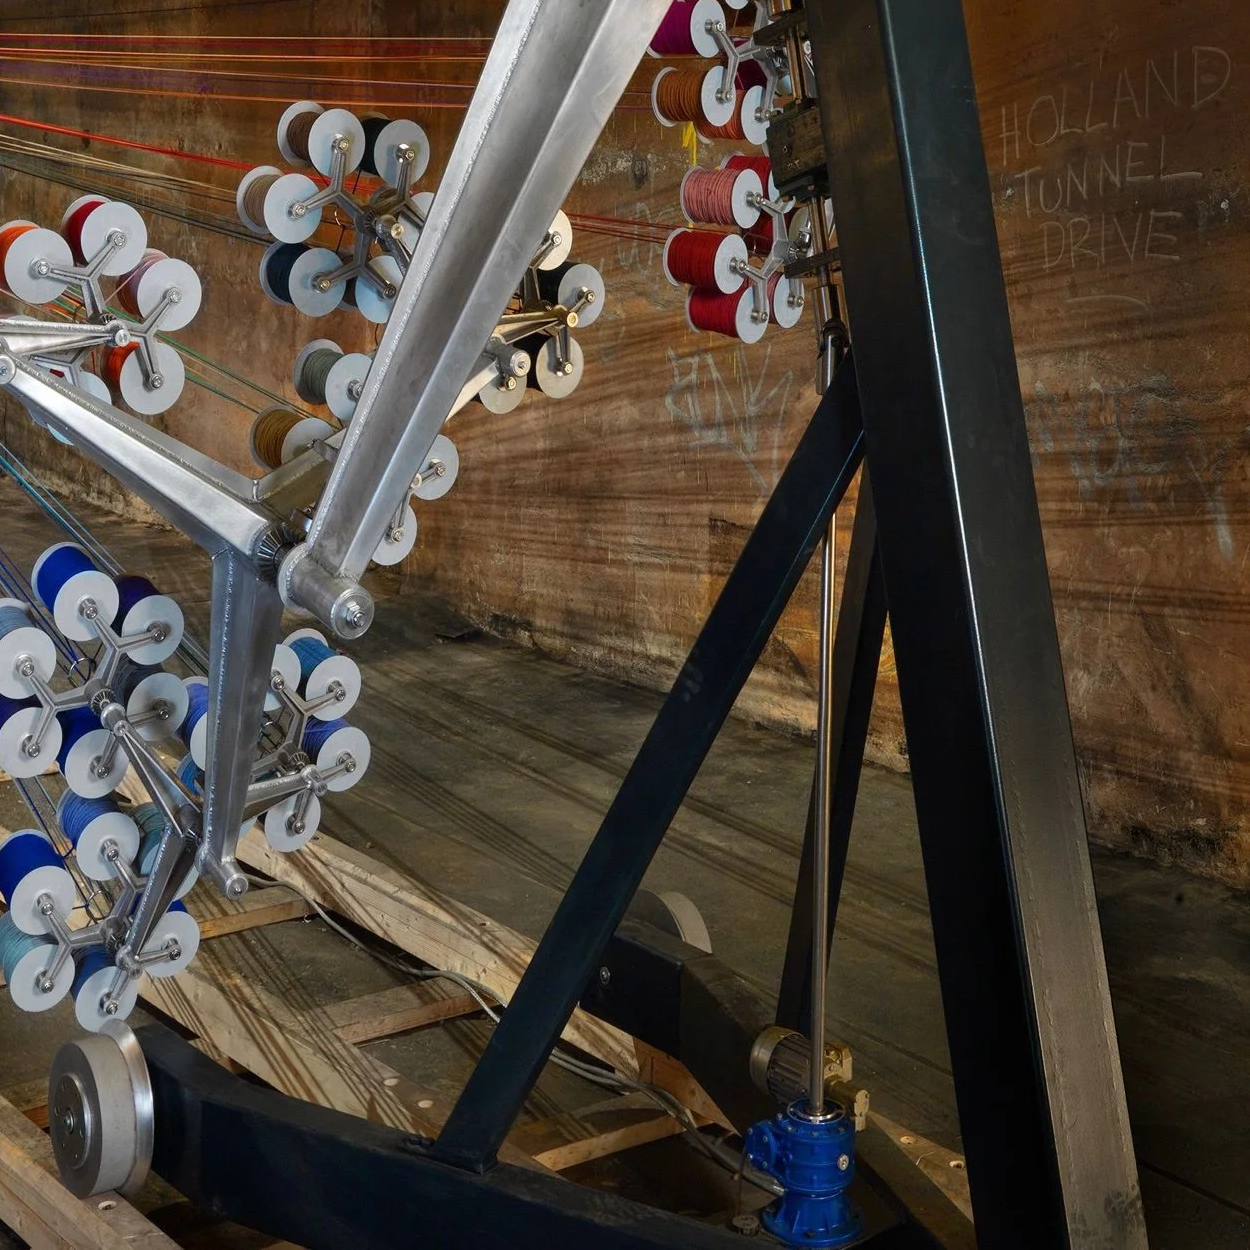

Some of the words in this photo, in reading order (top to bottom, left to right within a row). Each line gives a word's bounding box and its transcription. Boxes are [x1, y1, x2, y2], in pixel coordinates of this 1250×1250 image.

[999, 45, 1232, 167] HOLLAND
[1014, 134, 1203, 218] TUNNEL
[1038, 208, 1183, 272] DRIVE
